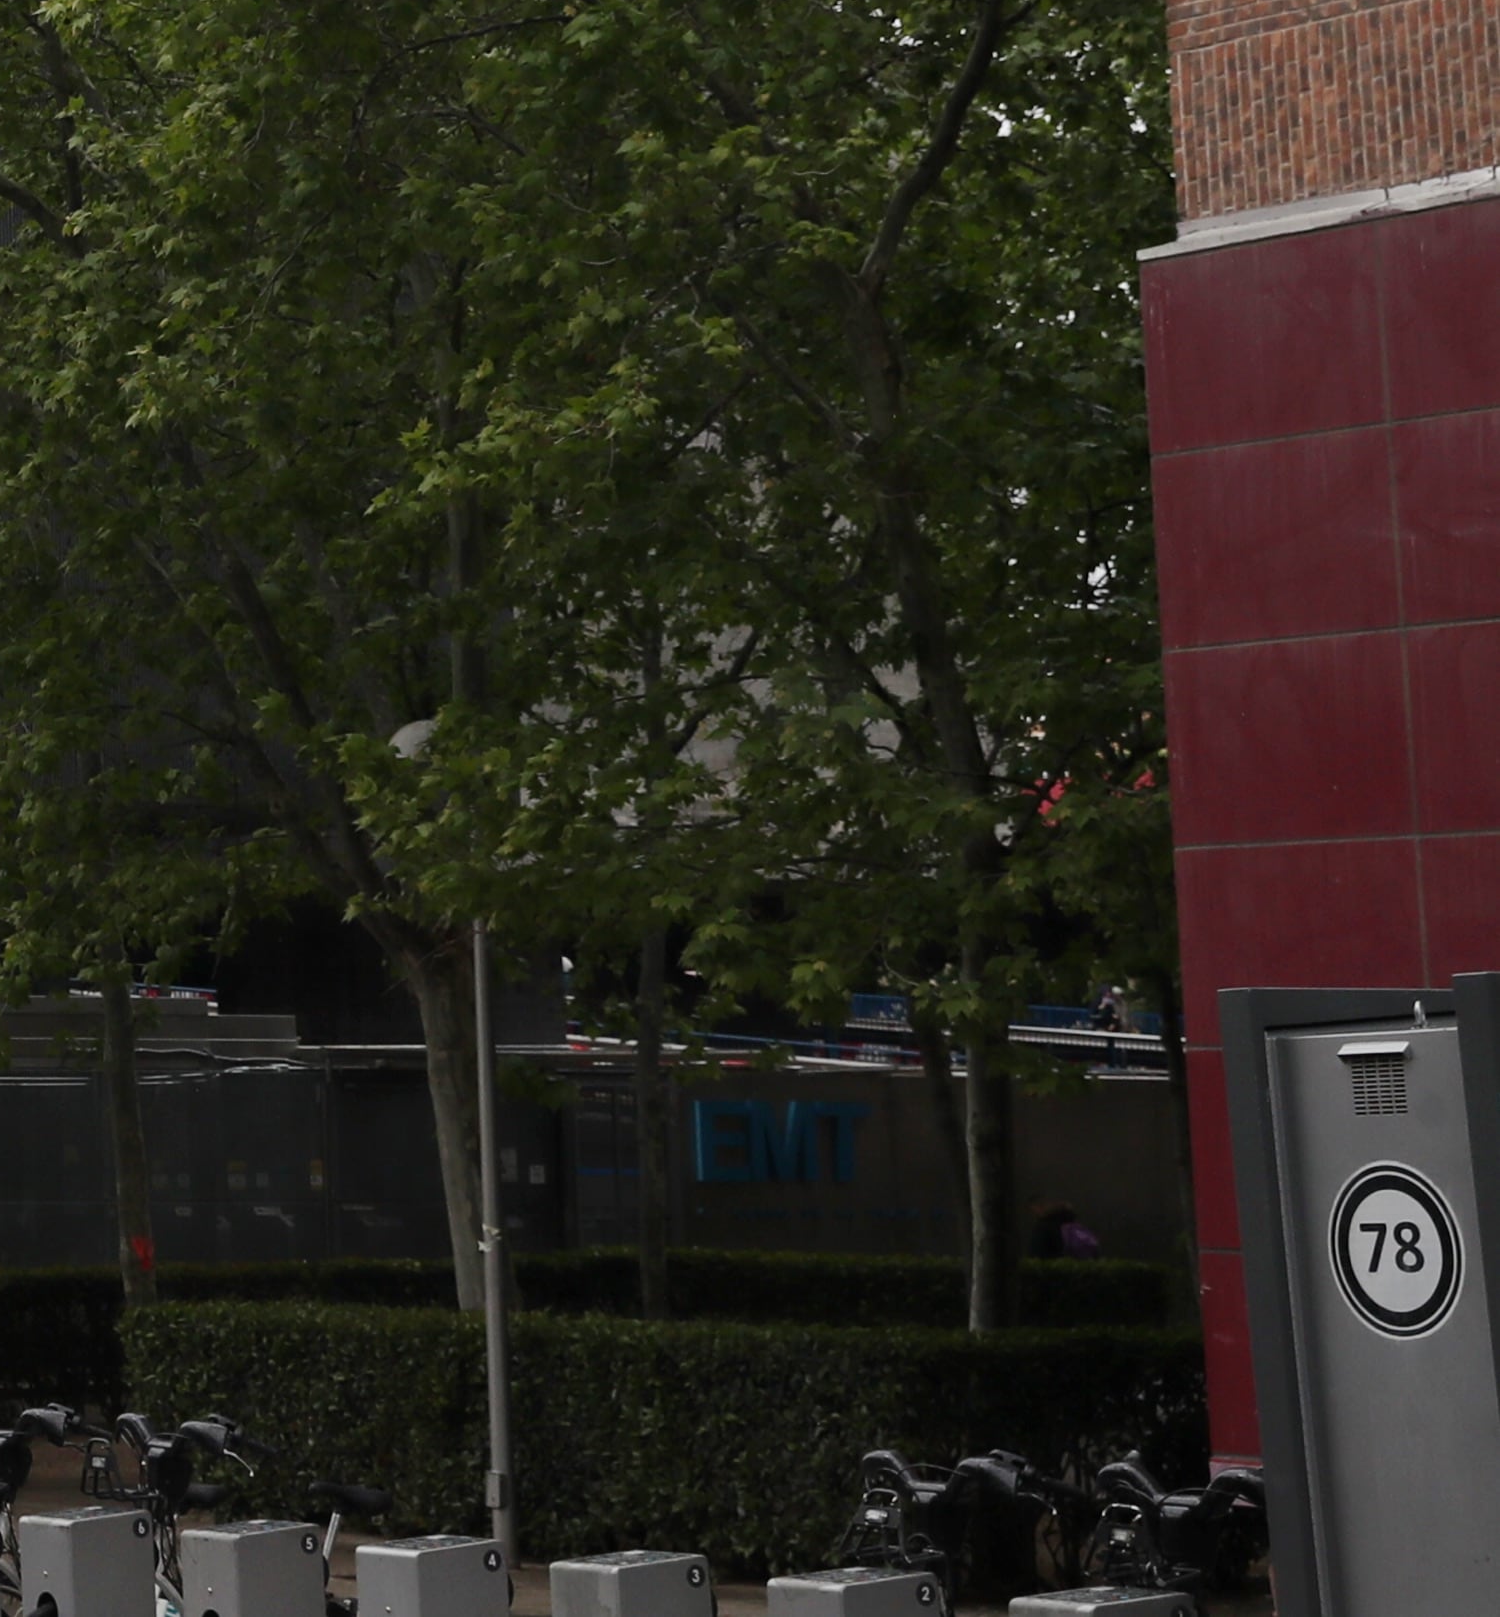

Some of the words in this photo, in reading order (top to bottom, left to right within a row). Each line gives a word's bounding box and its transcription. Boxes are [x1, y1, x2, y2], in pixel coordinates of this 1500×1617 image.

[693, 1099, 872, 1183] EMT
[1359, 1221, 1425, 1274] 78
[137, 1522, 146, 1535] 6
[305, 1537, 314, 1551] 5
[488, 1553, 497, 1568] 4
[691, 1568, 700, 1583] 3
[921, 1587, 931, 1602] 2
